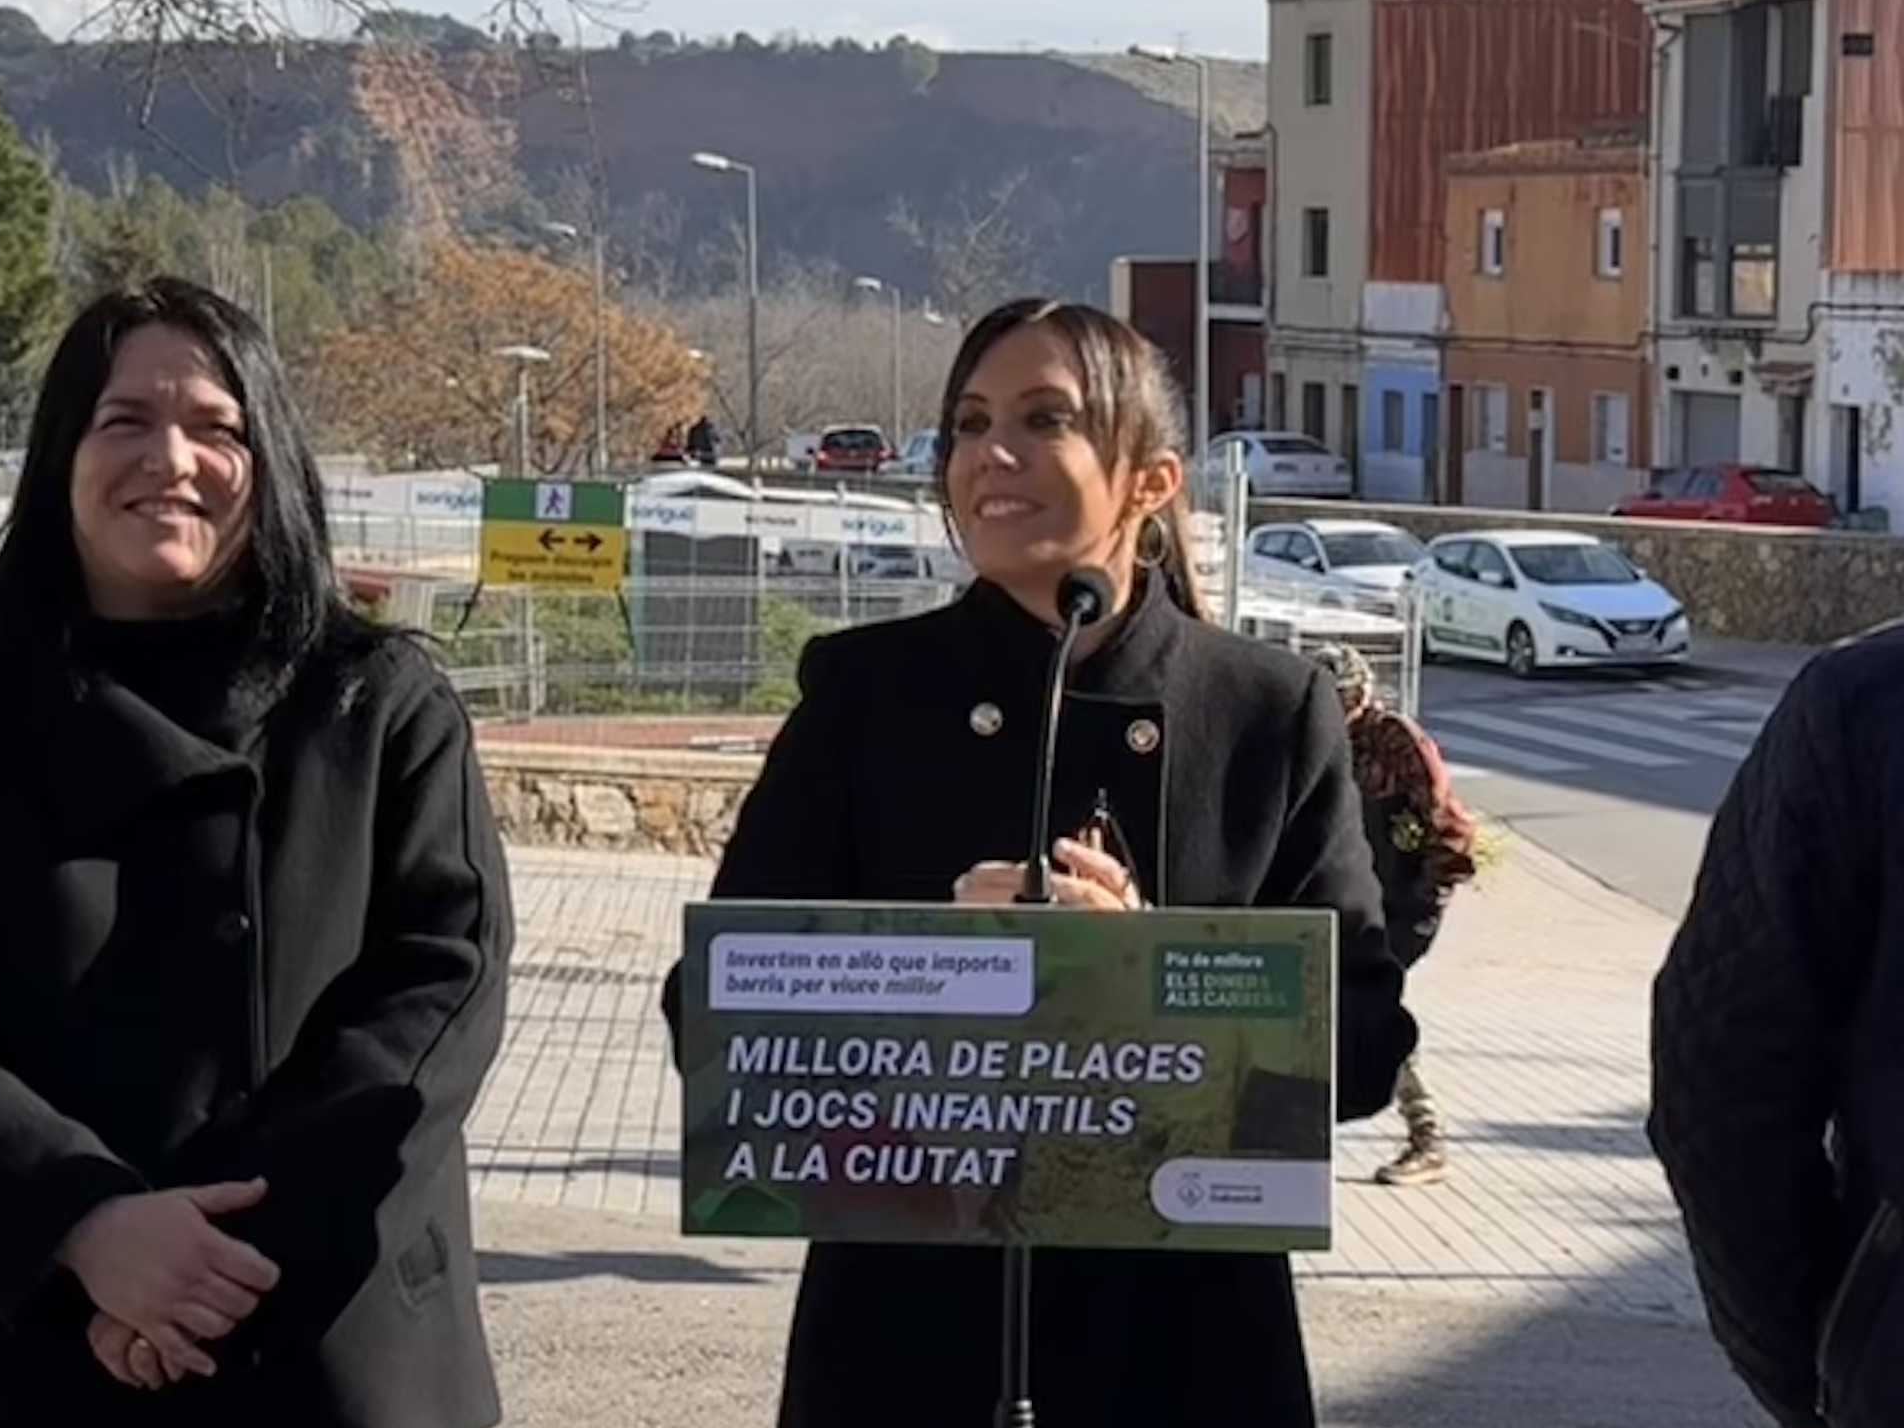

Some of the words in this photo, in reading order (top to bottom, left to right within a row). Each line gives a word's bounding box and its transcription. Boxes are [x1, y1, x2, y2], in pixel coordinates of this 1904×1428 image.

[726, 948, 812, 970] Invertim
[816, 952, 842, 970] en
[847, 950, 884, 971] allò
[889, 955, 926, 977] que
[1164, 951, 1190, 968] Pla
[1192, 951, 1210, 968] de
[1212, 951, 1265, 969] millora
[726, 974, 786, 994] barris
[788, 978, 823, 998] per
[829, 976, 880, 995] viure
[884, 976, 947, 996] millor
[1165, 973, 1200, 989] ELS
[1164, 991, 1201, 1006] ALS
[726, 1035, 934, 1078] MILLORA
[946, 1039, 1010, 1078] DE
[1019, 1041, 1206, 1083] PLACES
[726, 1088, 741, 1126] I
[753, 1089, 879, 1130] JOCS
[890, 1091, 1138, 1135] INFANTILS
[723, 1142, 757, 1181] A
[770, 1144, 830, 1182] LA
[843, 1145, 1018, 1185] CIUTAT
